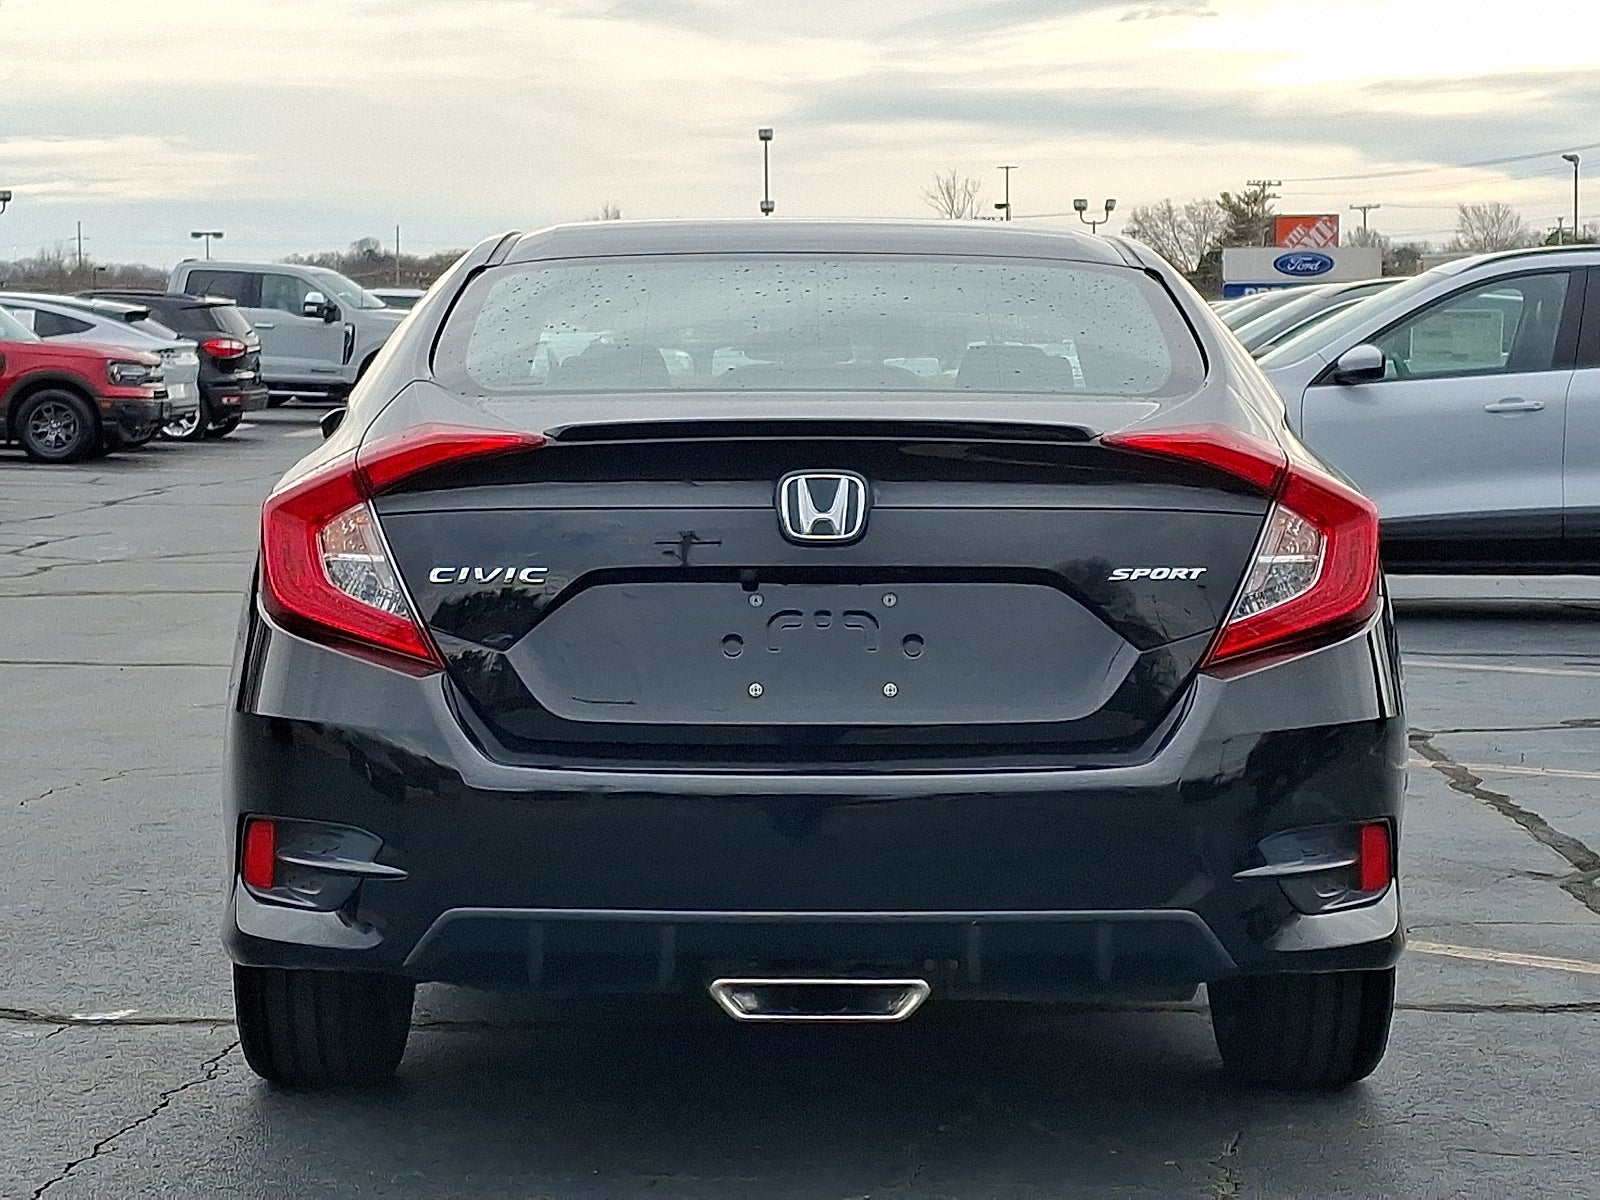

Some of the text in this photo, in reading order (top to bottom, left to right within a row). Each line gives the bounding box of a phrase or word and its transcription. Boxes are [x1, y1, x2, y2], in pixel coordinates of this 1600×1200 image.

[1287, 256, 1322, 272] Ford
[428, 566, 549, 584] CIVIC
[1106, 567, 1208, 582] SPORT
